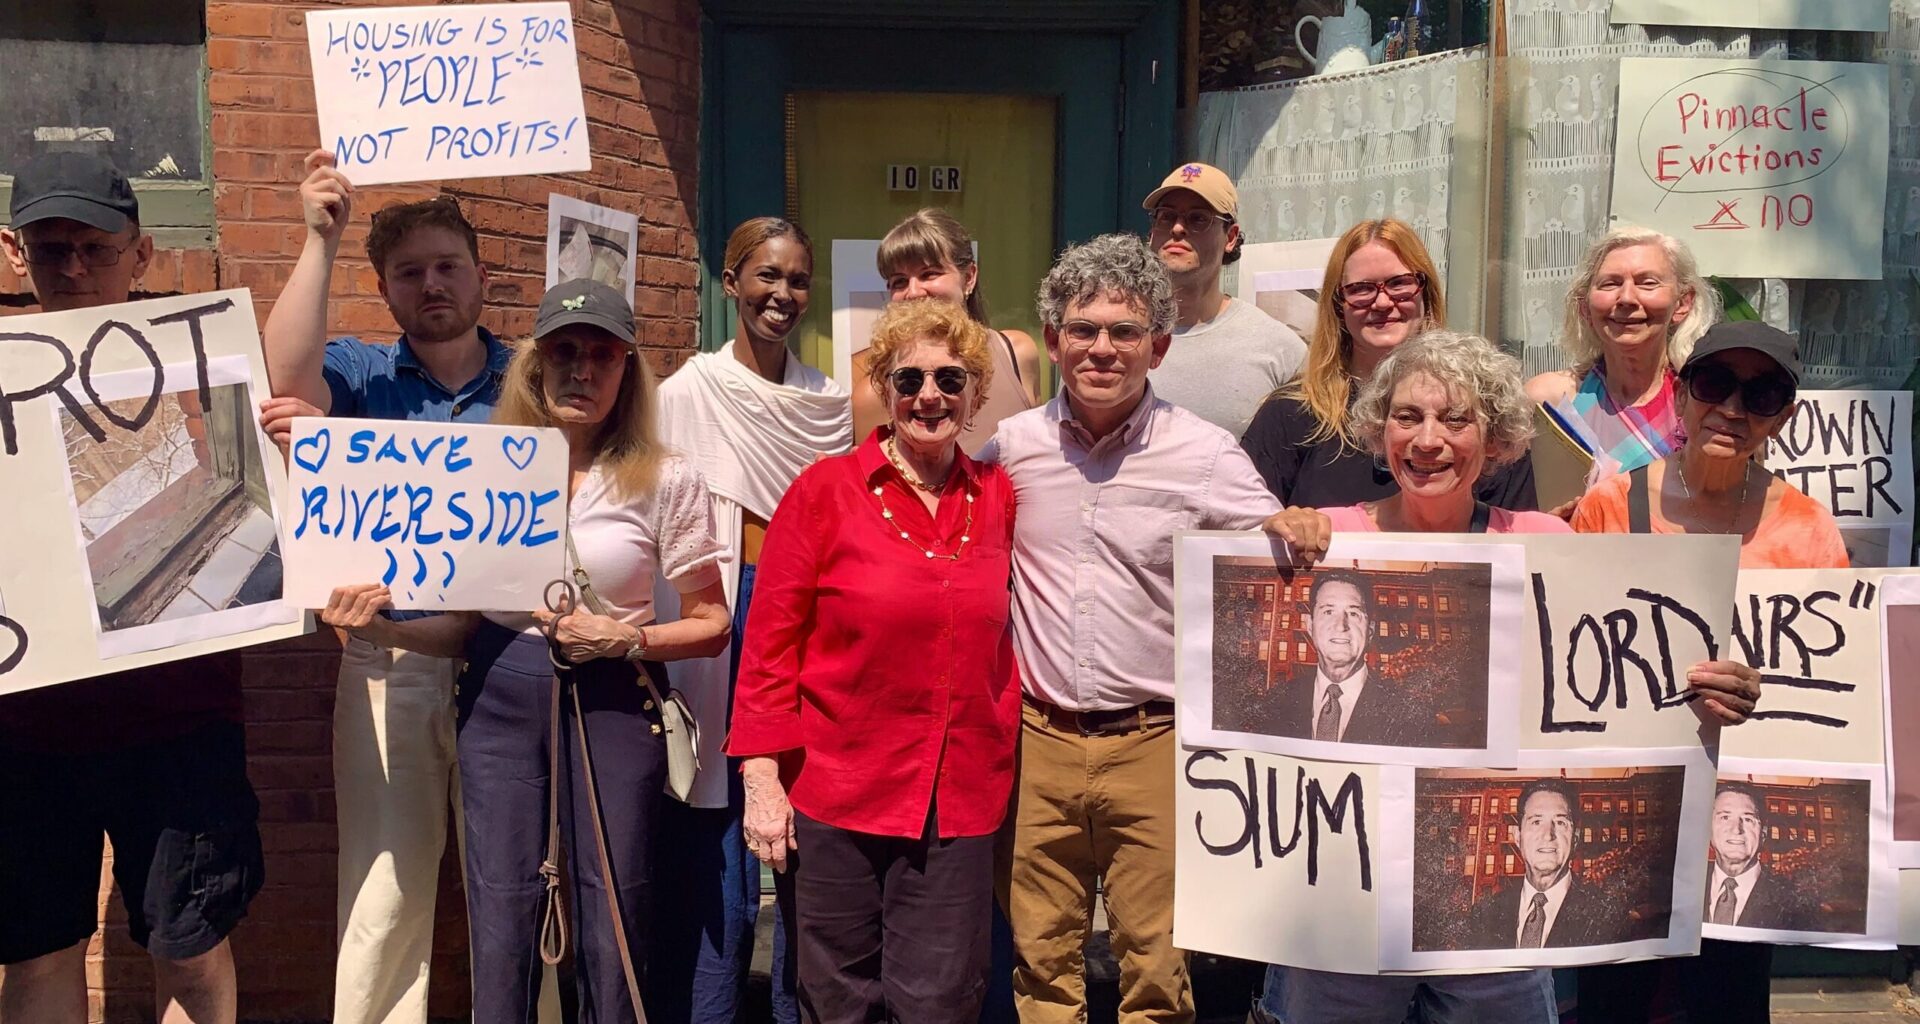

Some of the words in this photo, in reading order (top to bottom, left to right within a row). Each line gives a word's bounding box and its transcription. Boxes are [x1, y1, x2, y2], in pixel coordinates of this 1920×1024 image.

[326, 18, 463, 56] HOUSING
[474, 16, 508, 46] IS
[521, 16, 569, 46] FOR
[378, 51, 514, 109] PEOPLE
[1676, 86, 1829, 134] Pinnacle
[334, 126, 409, 169] NOT
[425, 117, 579, 162] PROFITS!
[1655, 143, 1824, 182] Evictions
[931, 167, 960, 191] GR
[0, 298, 235, 456] ROT
[346, 430, 473, 473] SAVE
[294, 481, 561, 547] RIVERSIDE
[1531, 572, 1720, 734] LORD
